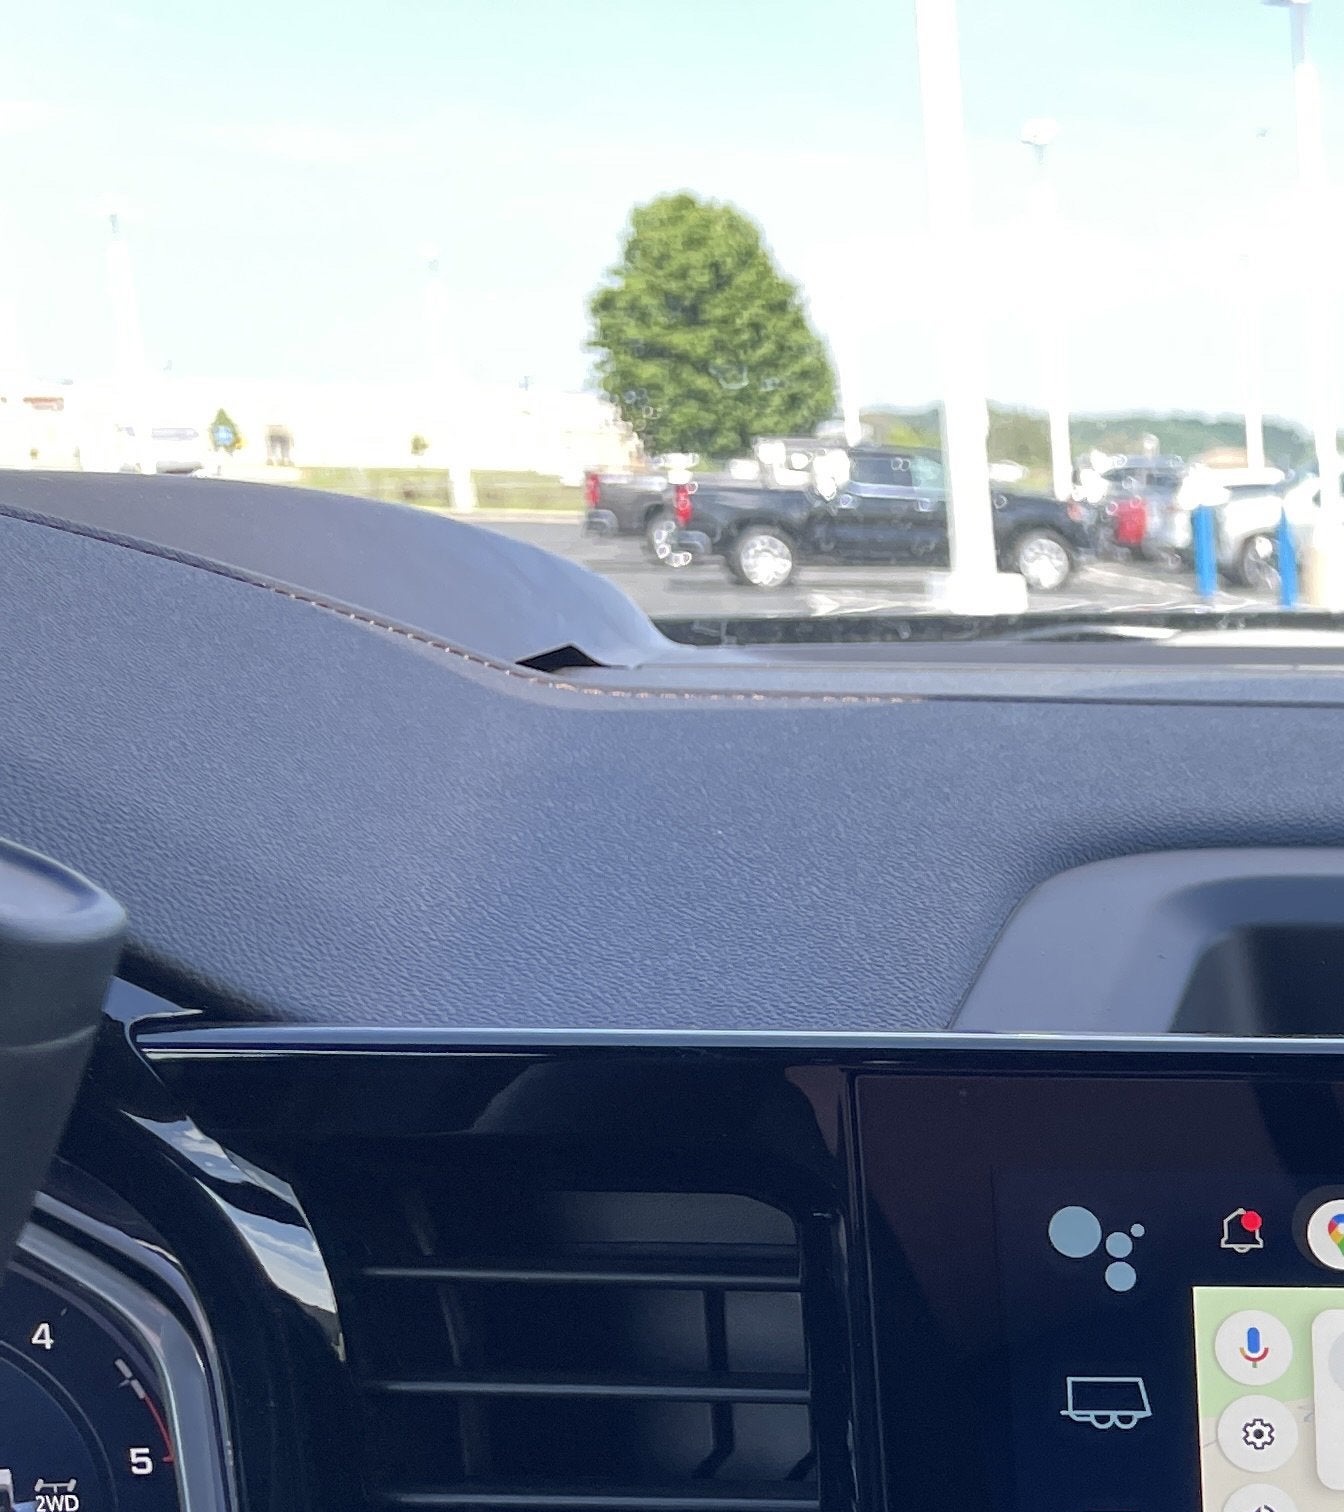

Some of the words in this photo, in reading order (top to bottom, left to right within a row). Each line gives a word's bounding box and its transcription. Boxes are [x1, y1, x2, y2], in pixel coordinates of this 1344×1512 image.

[31, 1322, 54, 1350] 4
[130, 1447, 153, 1476] 5
[36, 1495, 79, 1512] 2WD
